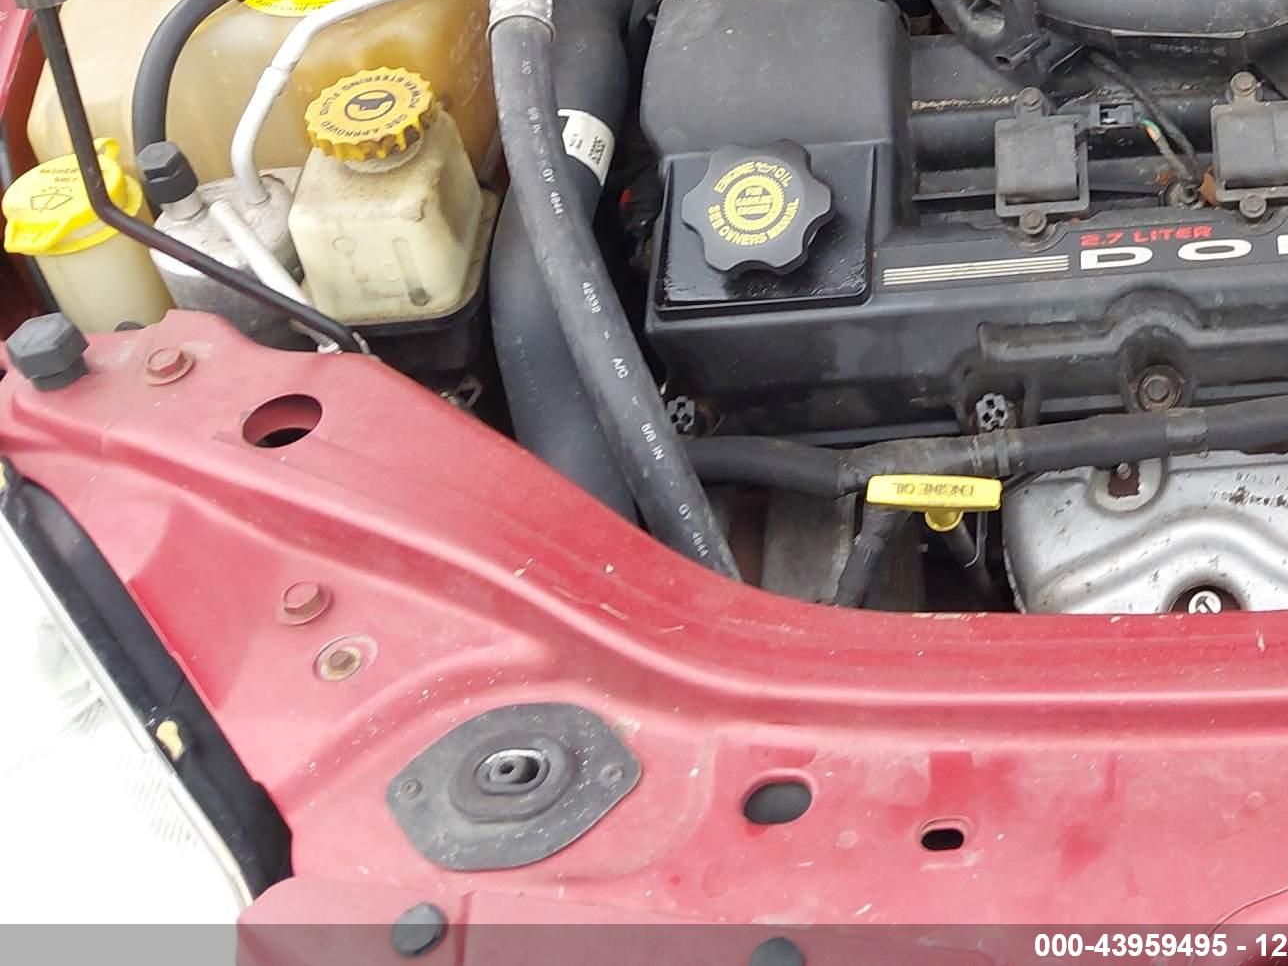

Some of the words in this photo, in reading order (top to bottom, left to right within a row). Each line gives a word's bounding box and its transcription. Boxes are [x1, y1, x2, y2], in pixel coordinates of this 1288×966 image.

[341, 74, 405, 92] STEERING
[320, 120, 380, 137] APPROVED
[714, 161, 755, 194] ENGINE
[774, 165, 793, 188] OIL
[707, 203, 725, 230] SEE
[766, 197, 800, 240] MANUAL
[1080, 232, 1123, 247] 2.7
[1133, 224, 1214, 244] LITER
[652, 444, 665, 462] IN
[890, 482, 916, 496] OIL
